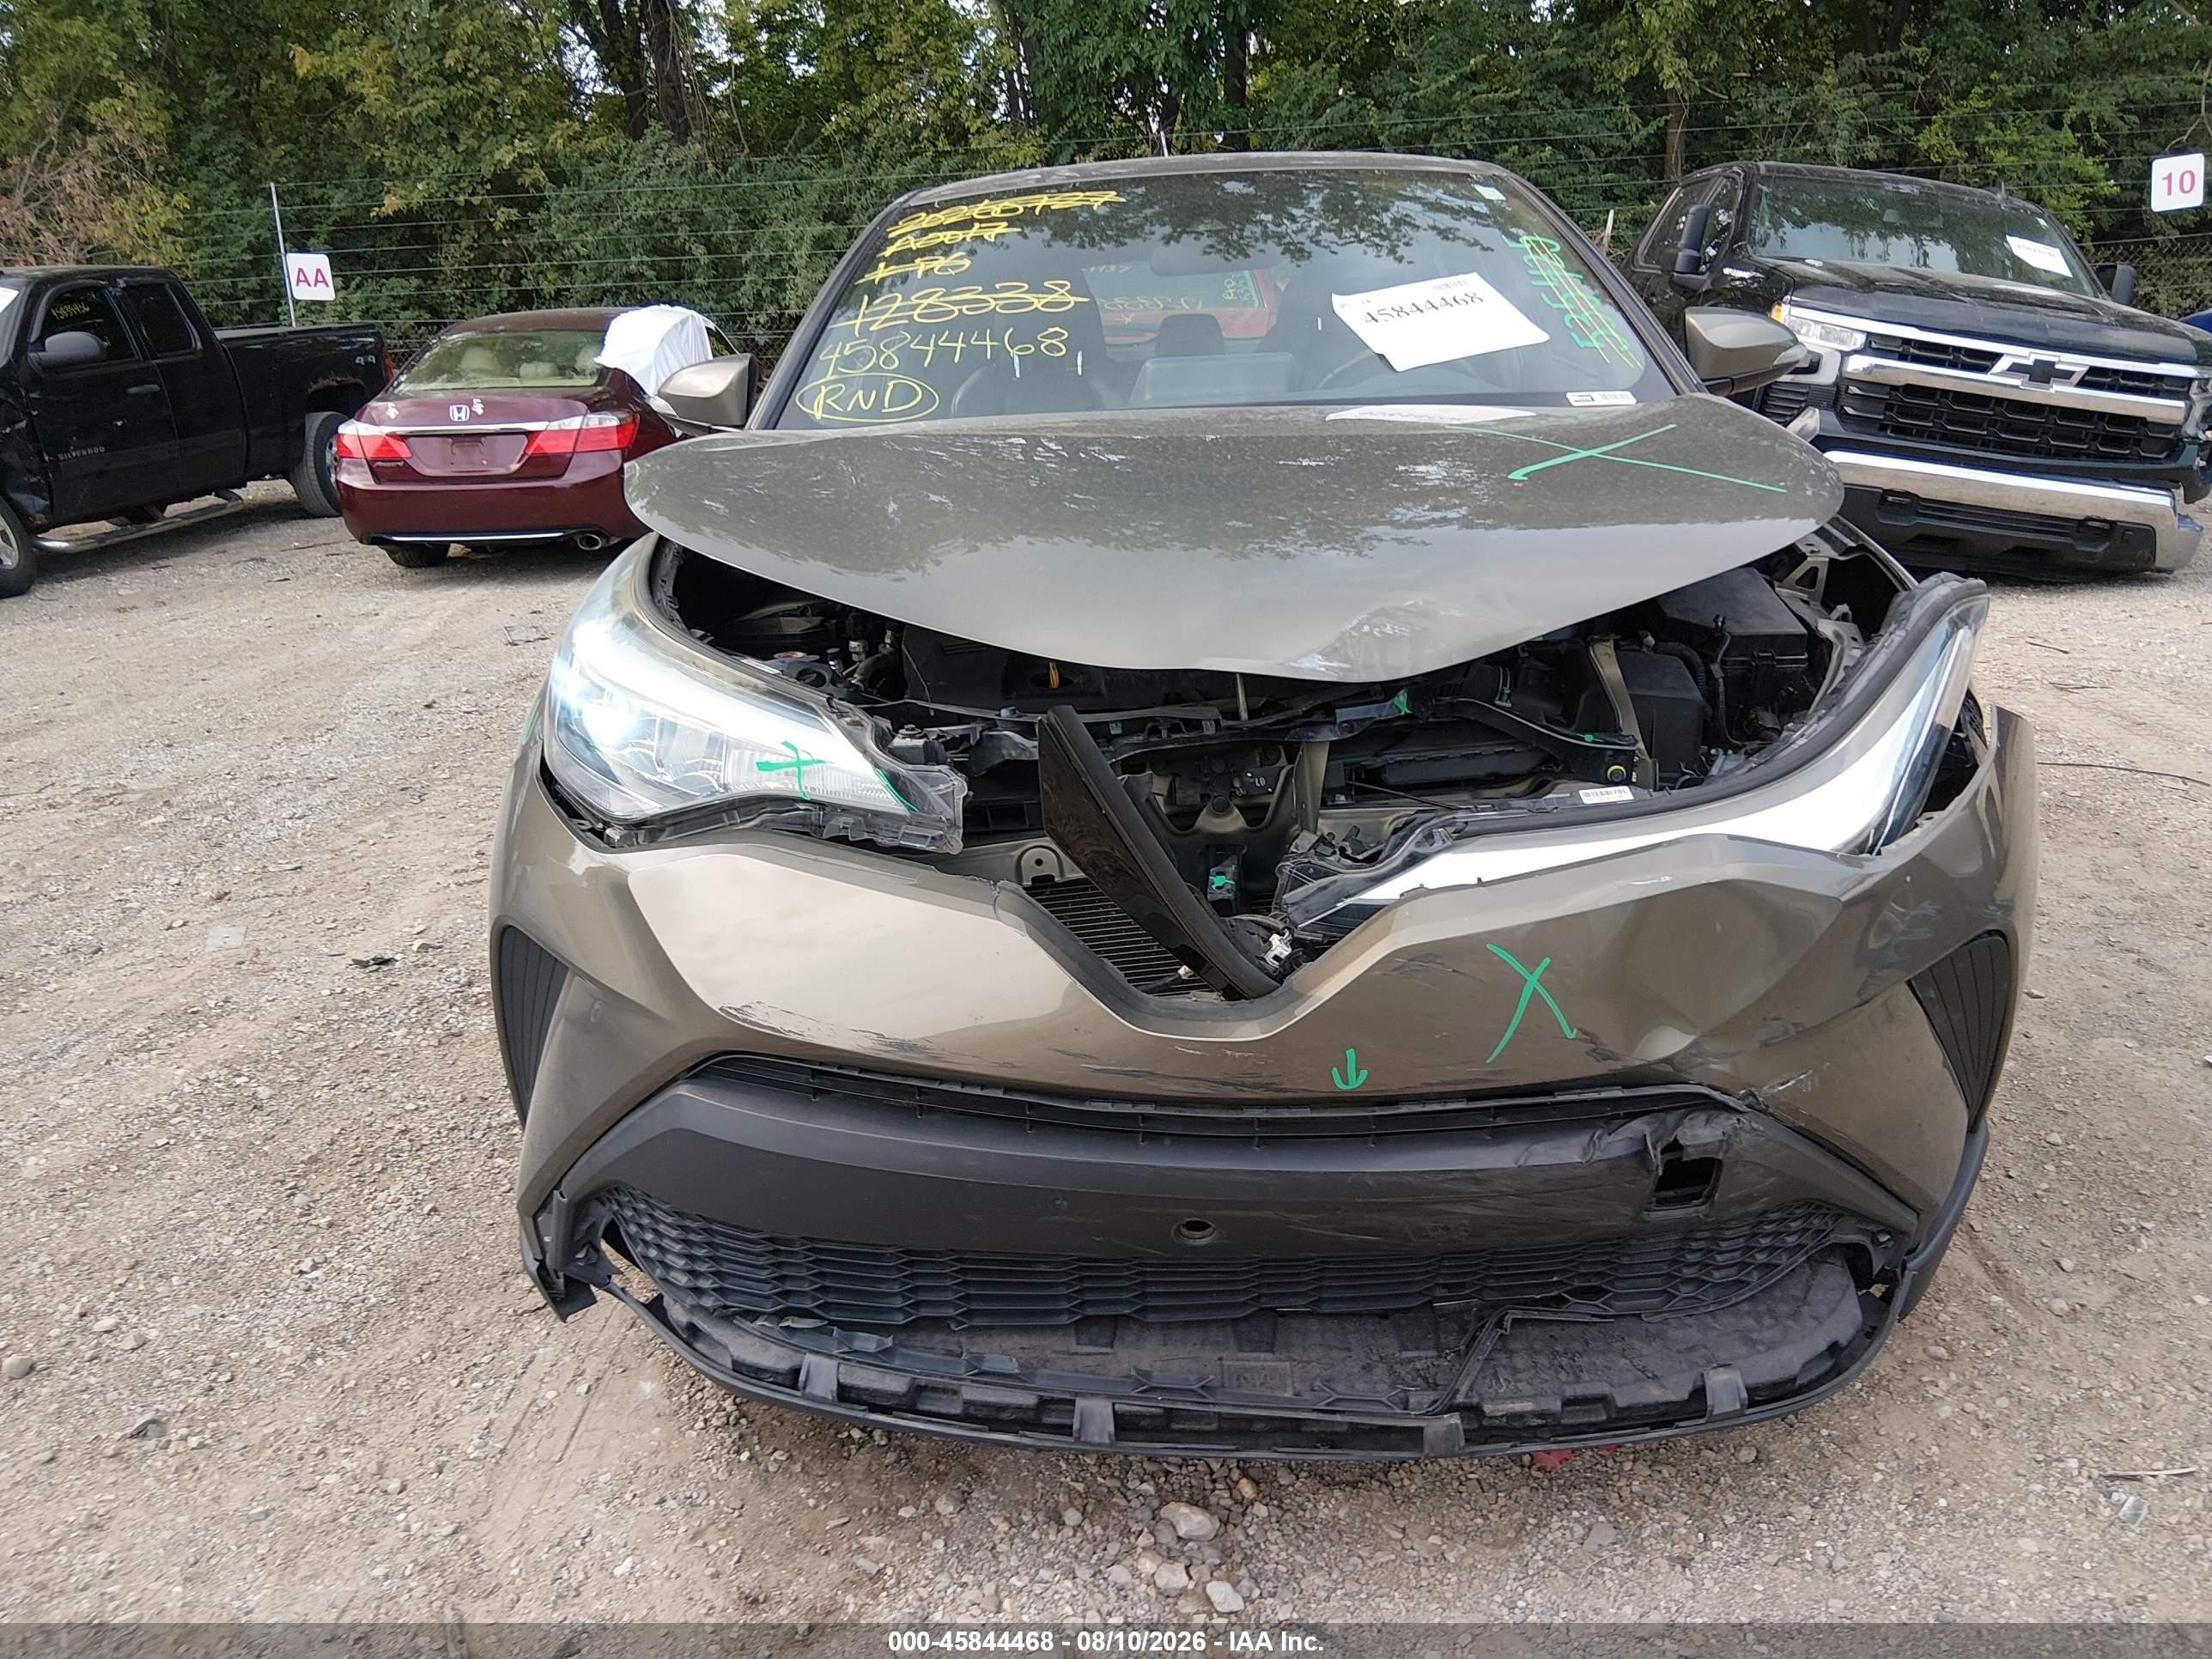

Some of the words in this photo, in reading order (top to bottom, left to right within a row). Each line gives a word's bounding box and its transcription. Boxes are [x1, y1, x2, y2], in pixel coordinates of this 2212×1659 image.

[2161, 169, 2196, 197] 10
[295, 267, 330, 288] AA
[1364, 292, 1484, 324] 45844468
[355, 355, 376, 366] 44
[818, 326, 1069, 379] 45844468
[813, 380, 923, 420] RND
